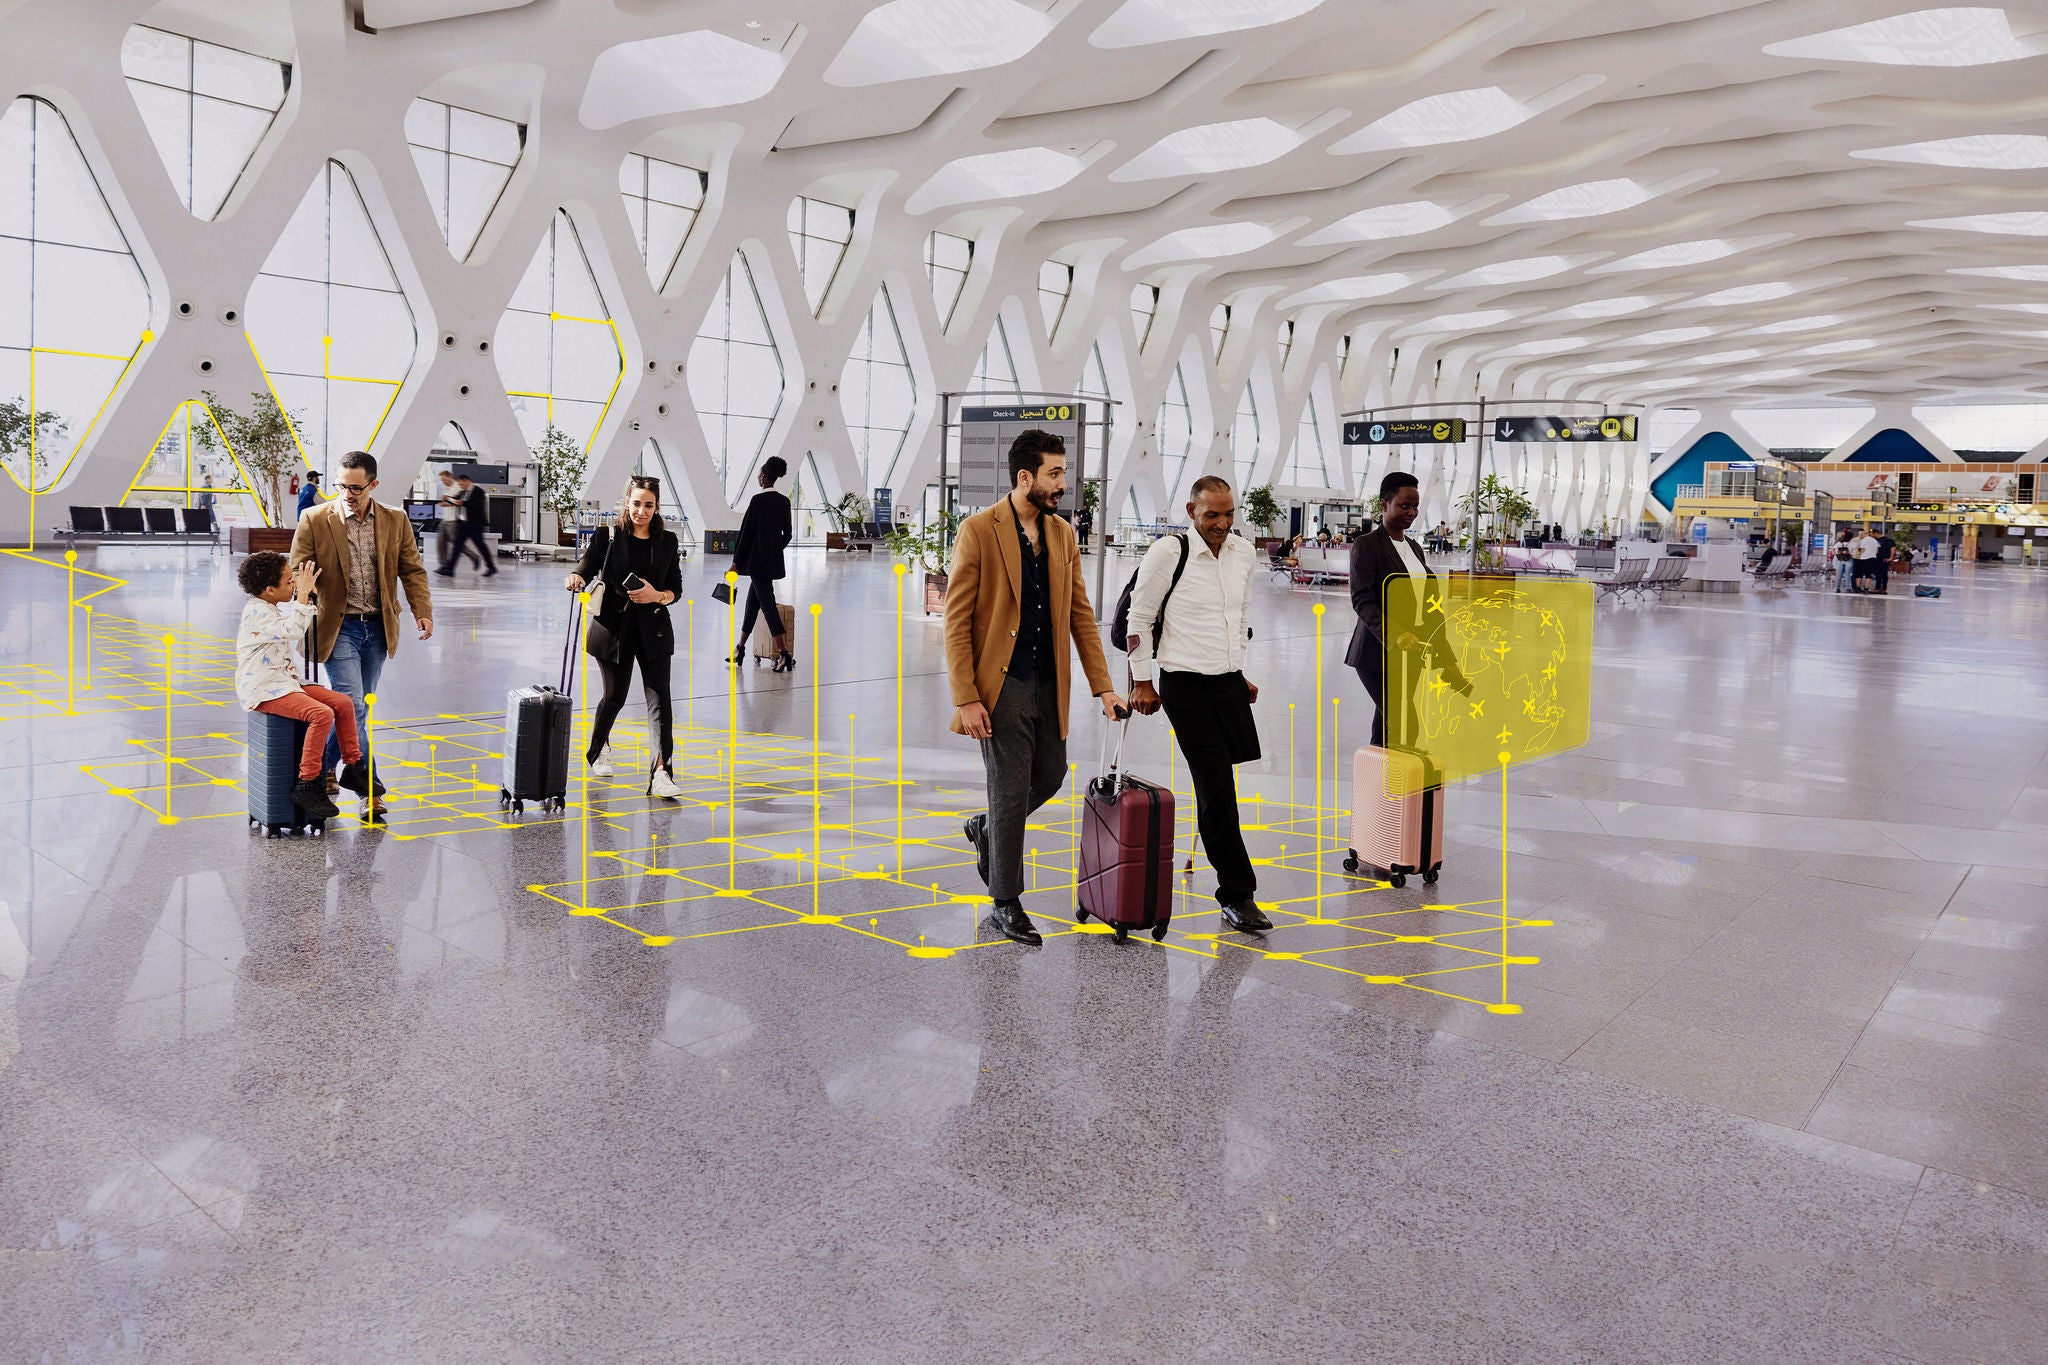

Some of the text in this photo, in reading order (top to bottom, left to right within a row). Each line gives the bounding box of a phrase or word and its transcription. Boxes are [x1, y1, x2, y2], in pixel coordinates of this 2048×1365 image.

[993, 410, 1015, 418] Check-in
[1020, 409, 1043, 419] تسجيل
[1390, 423, 1431, 432] رحلات وطنية
[1573, 418, 1599, 428] تسجيل
